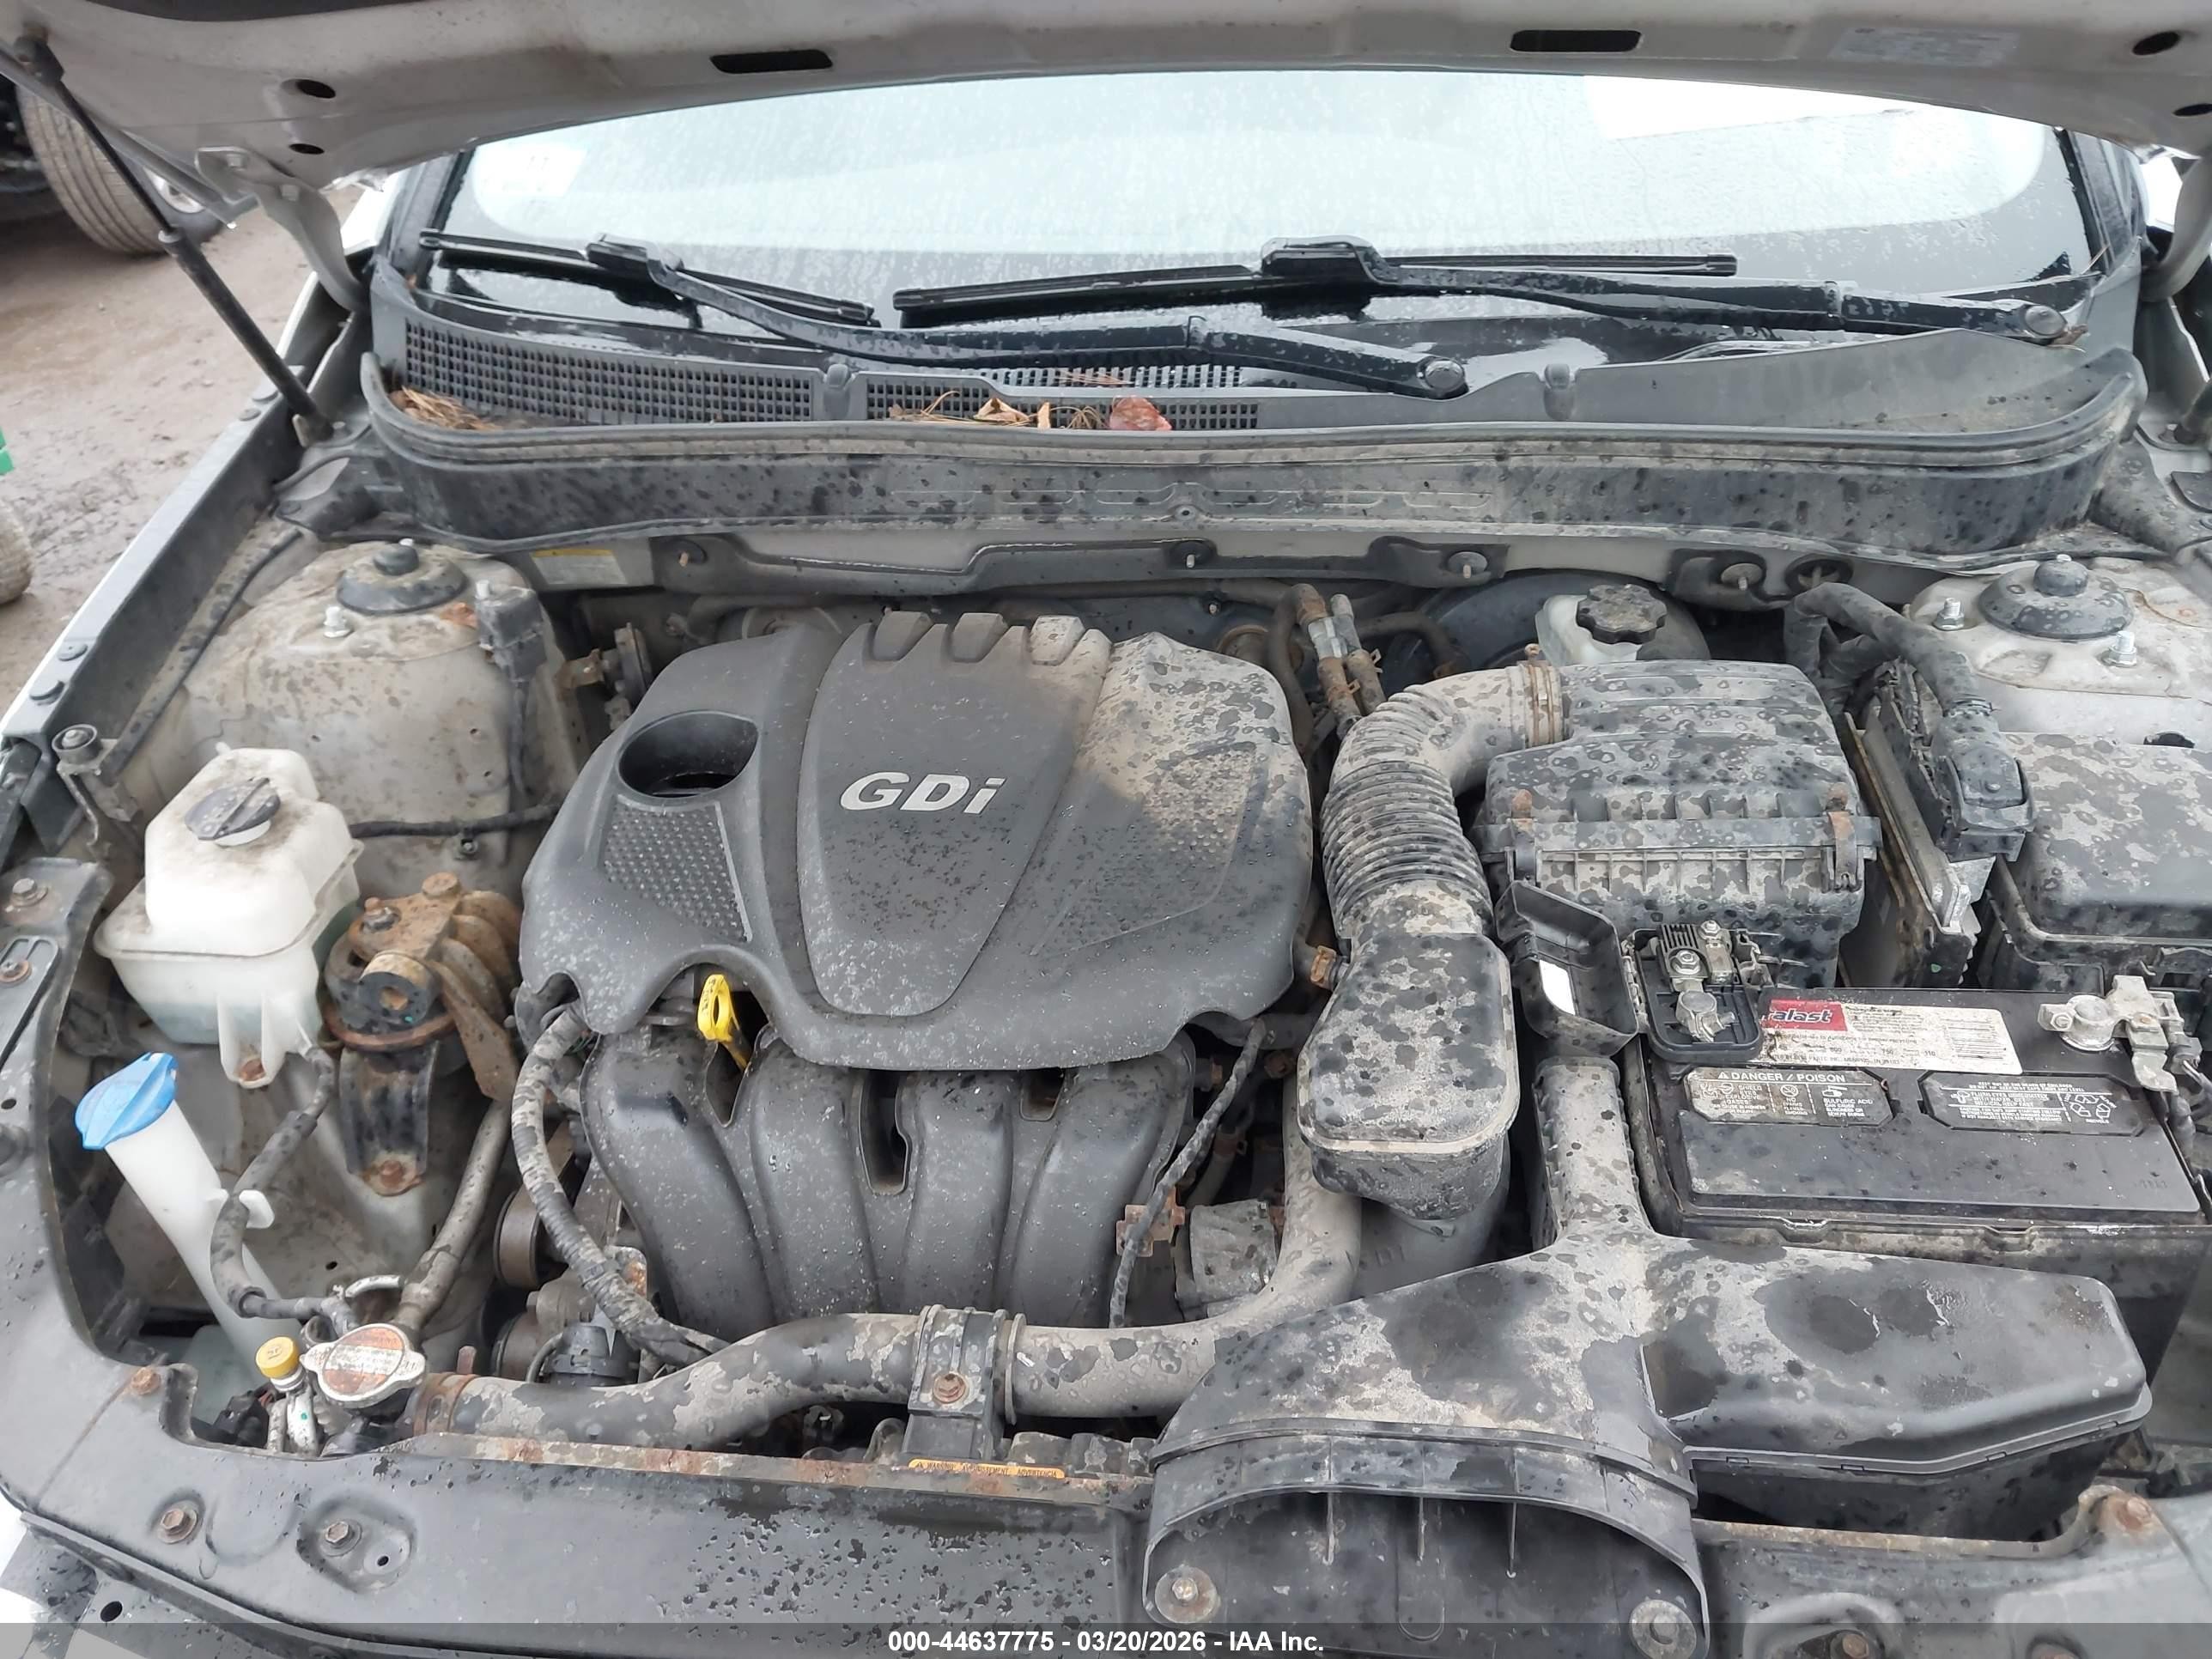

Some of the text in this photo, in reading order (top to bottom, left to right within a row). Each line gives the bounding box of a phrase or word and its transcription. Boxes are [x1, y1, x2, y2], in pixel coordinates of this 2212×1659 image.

[840, 771, 1006, 815] GDi
[1731, 1073, 1784, 1081] DANGER
[1796, 1073, 1846, 1083] POISON
